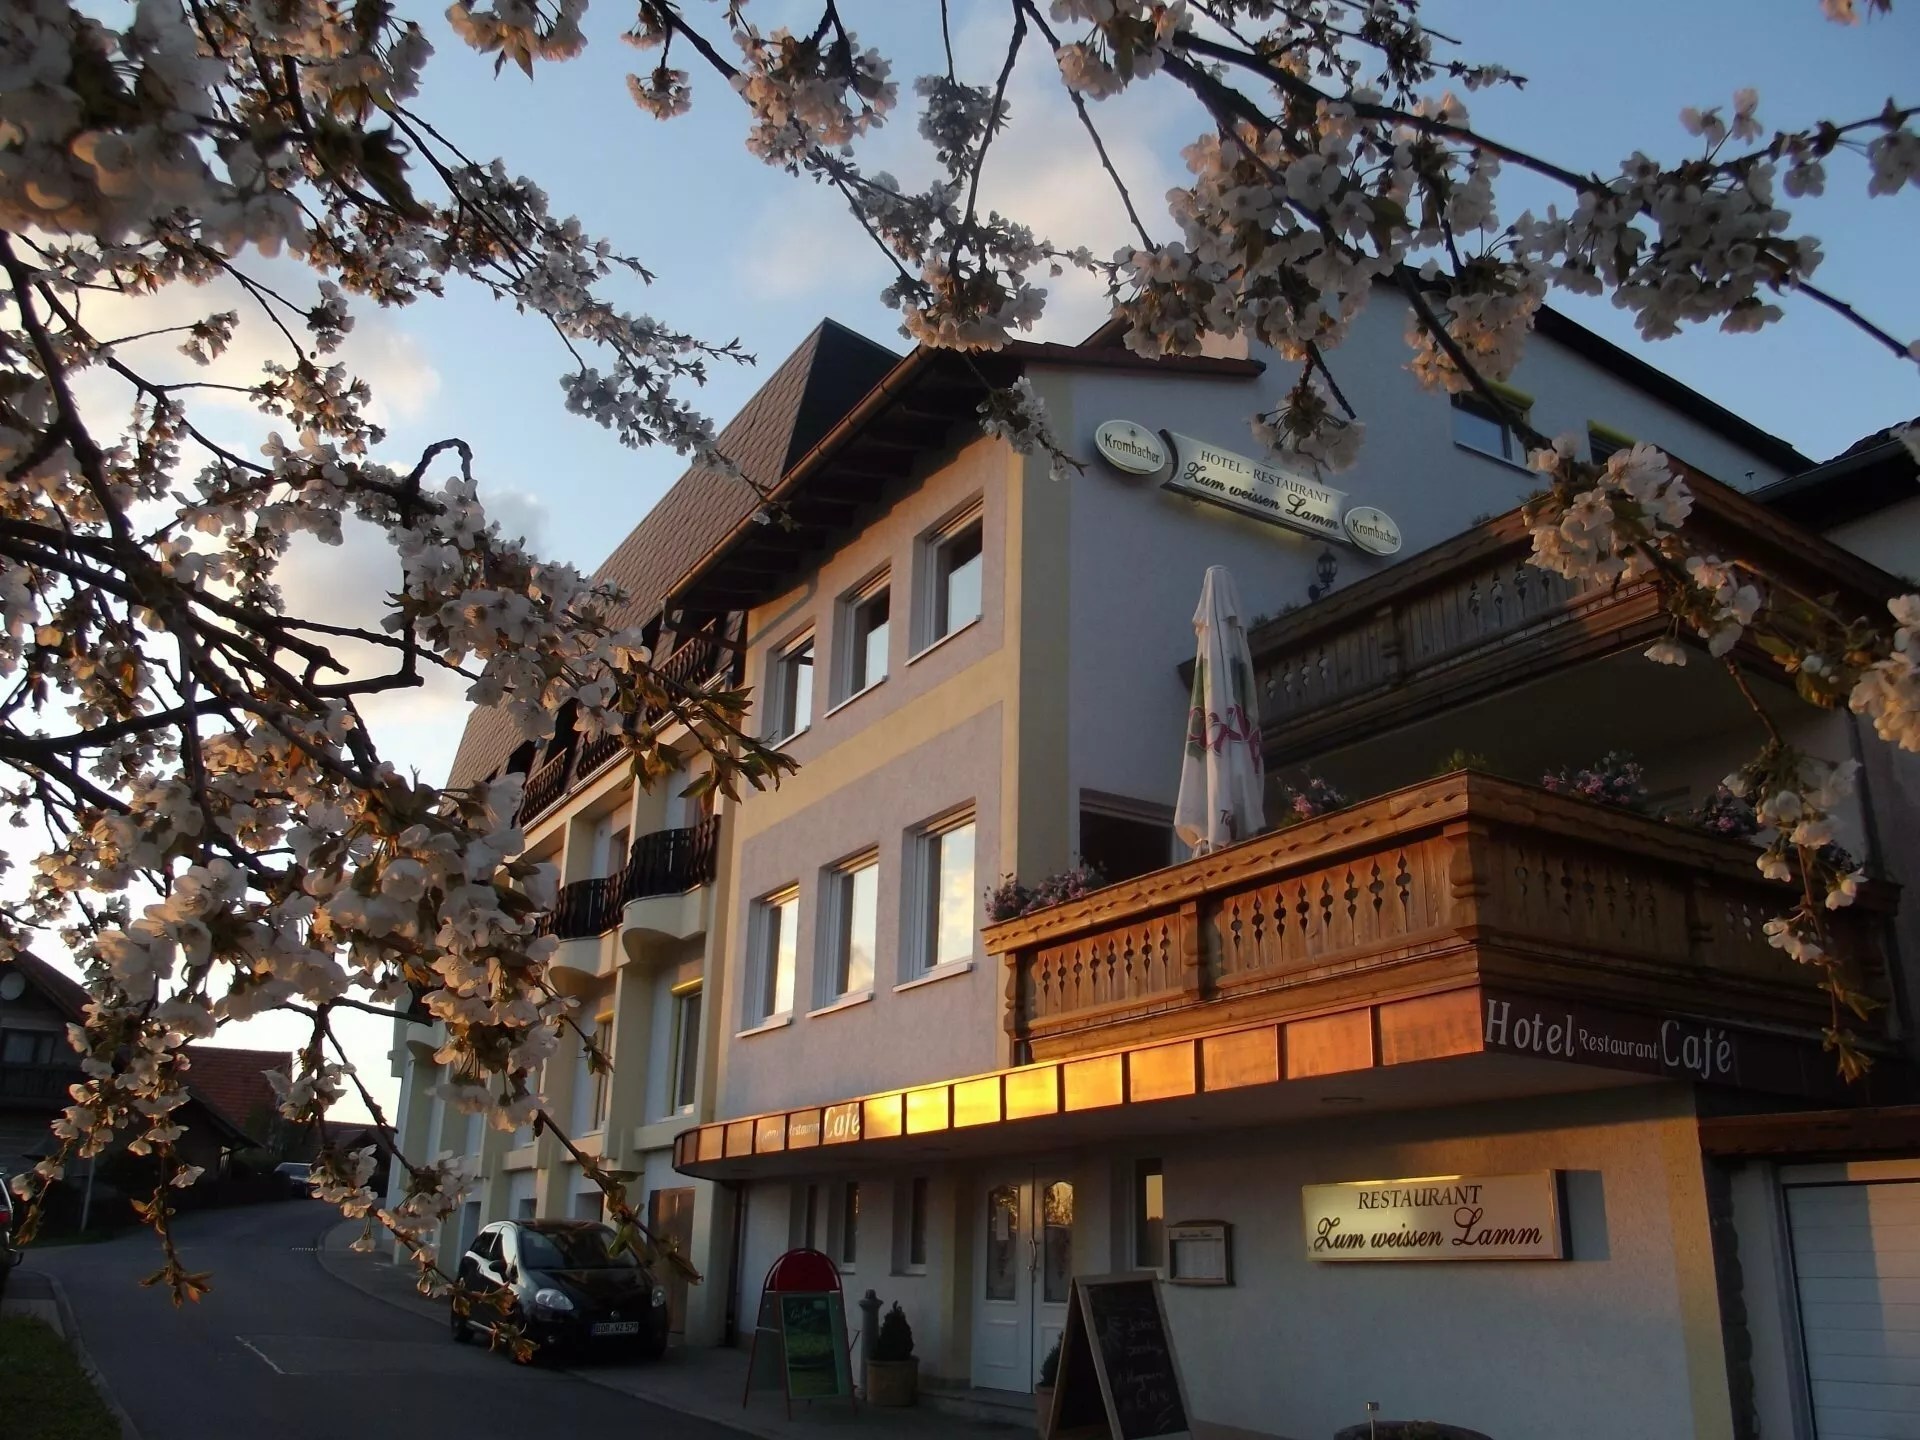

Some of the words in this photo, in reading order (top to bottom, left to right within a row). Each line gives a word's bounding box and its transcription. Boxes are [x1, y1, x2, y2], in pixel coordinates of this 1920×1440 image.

[1104, 433, 1160, 464] Krombacher
[1184, 461, 1226, 492] Zum
[1229, 486, 1280, 510] weissen
[1285, 493, 1340, 530] Lamm
[1201, 451, 1243, 474] HOTEL
[1253, 468, 1332, 504] RESTAURANT
[1352, 519, 1398, 546] Krombacher
[1484, 998, 1575, 1058] Hotel
[1578, 1028, 1659, 1060] Restaurant
[1661, 1019, 1732, 1080] Café
[1357, 1184, 1483, 1210] RESTAURANT
[1313, 1217, 1367, 1250] Zum
[1370, 1223, 1444, 1248] weissen
[1451, 1206, 1543, 1246] Lamm
